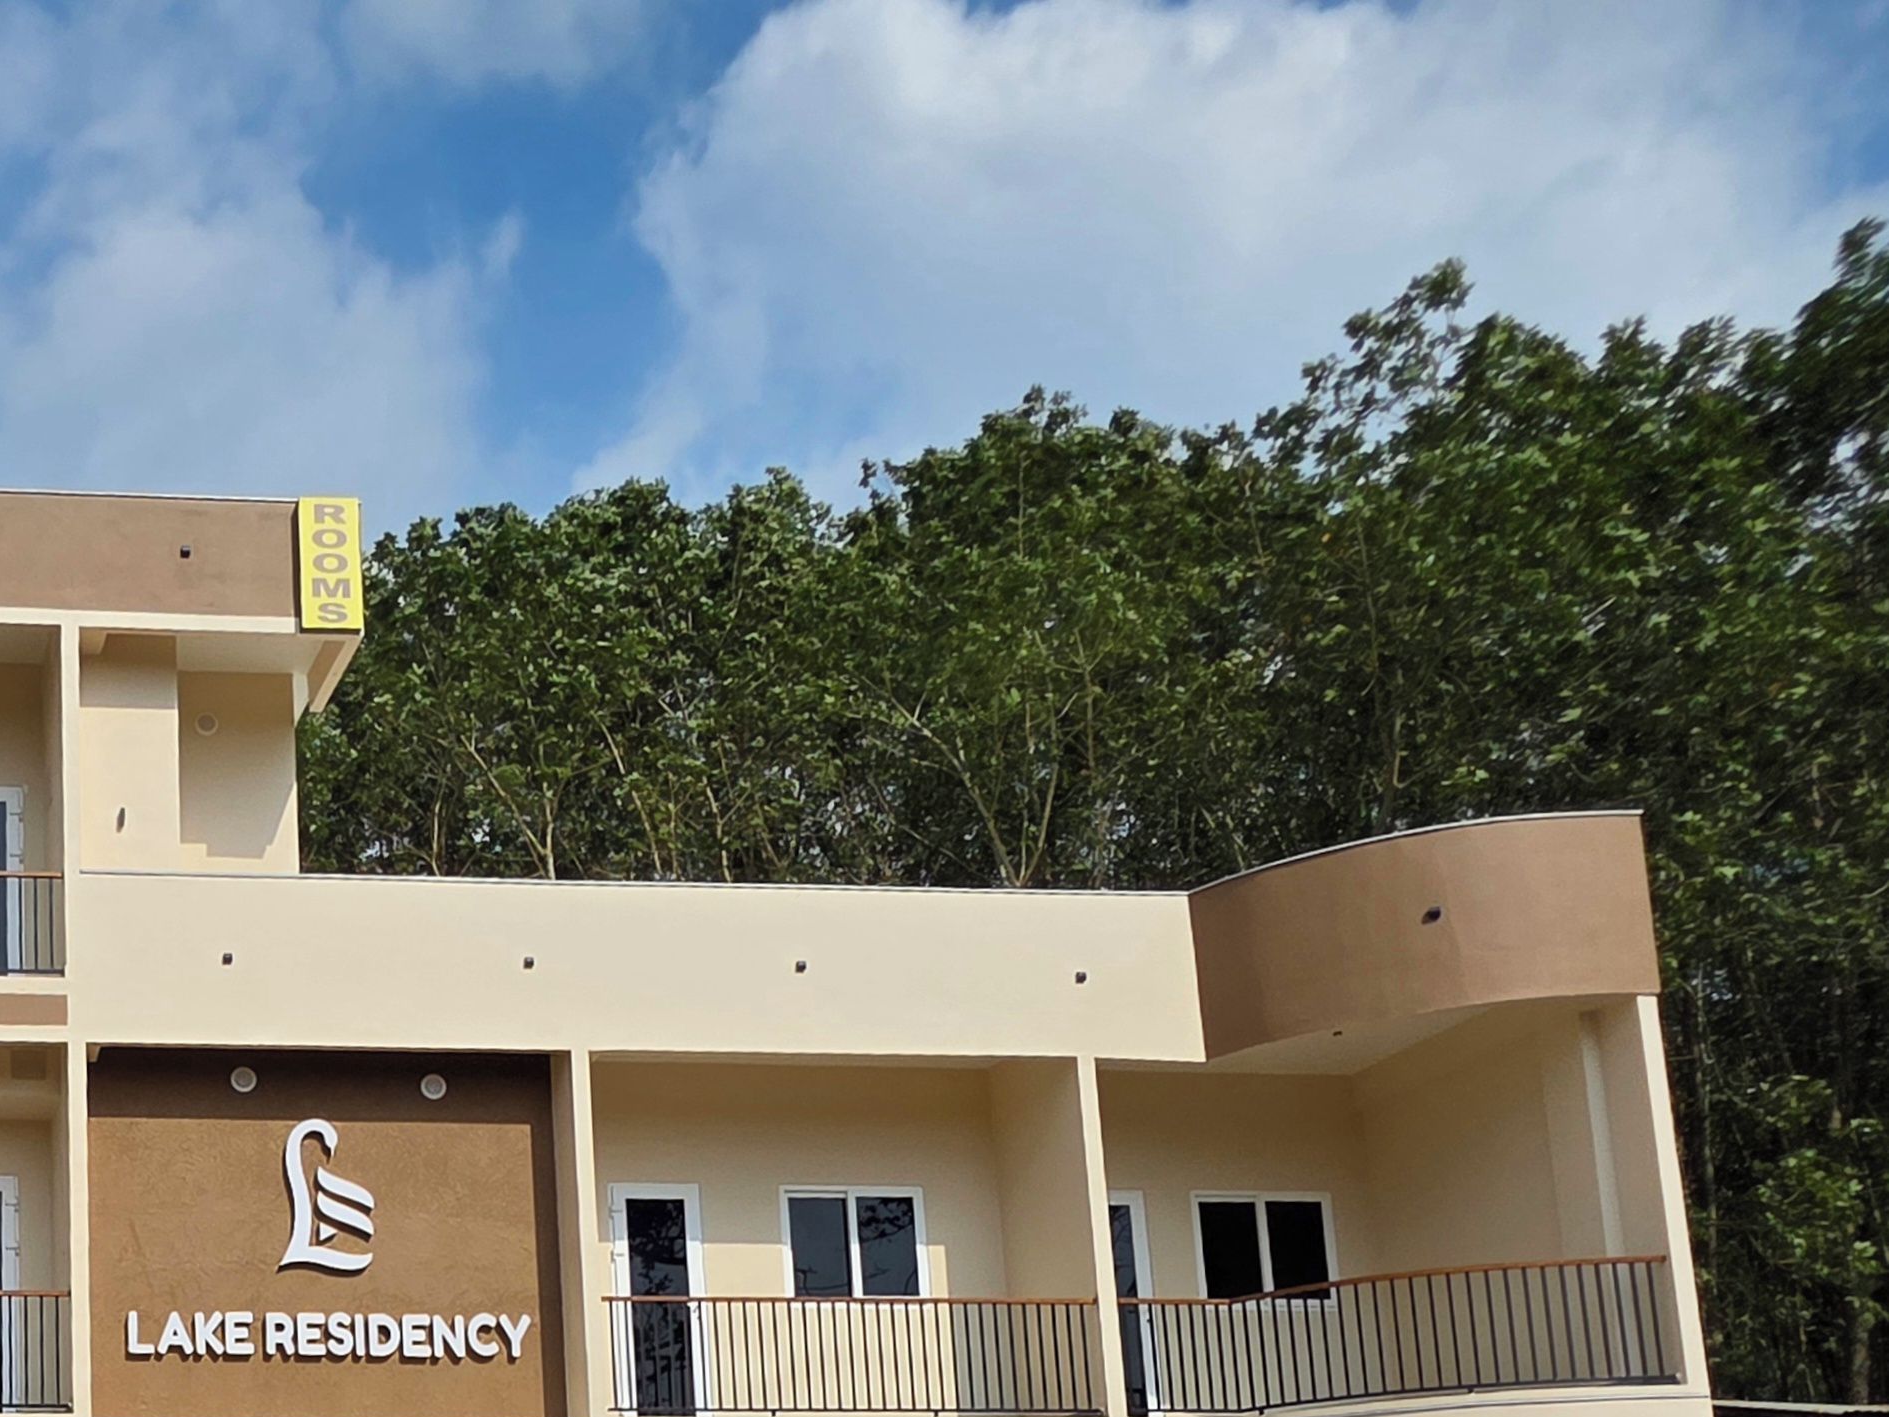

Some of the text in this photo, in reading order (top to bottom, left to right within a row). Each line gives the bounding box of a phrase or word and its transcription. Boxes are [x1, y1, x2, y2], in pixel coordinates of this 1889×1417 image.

[311, 503, 351, 623] ROOMS
[127, 1310, 531, 1358] LAKE RESIDENCY
